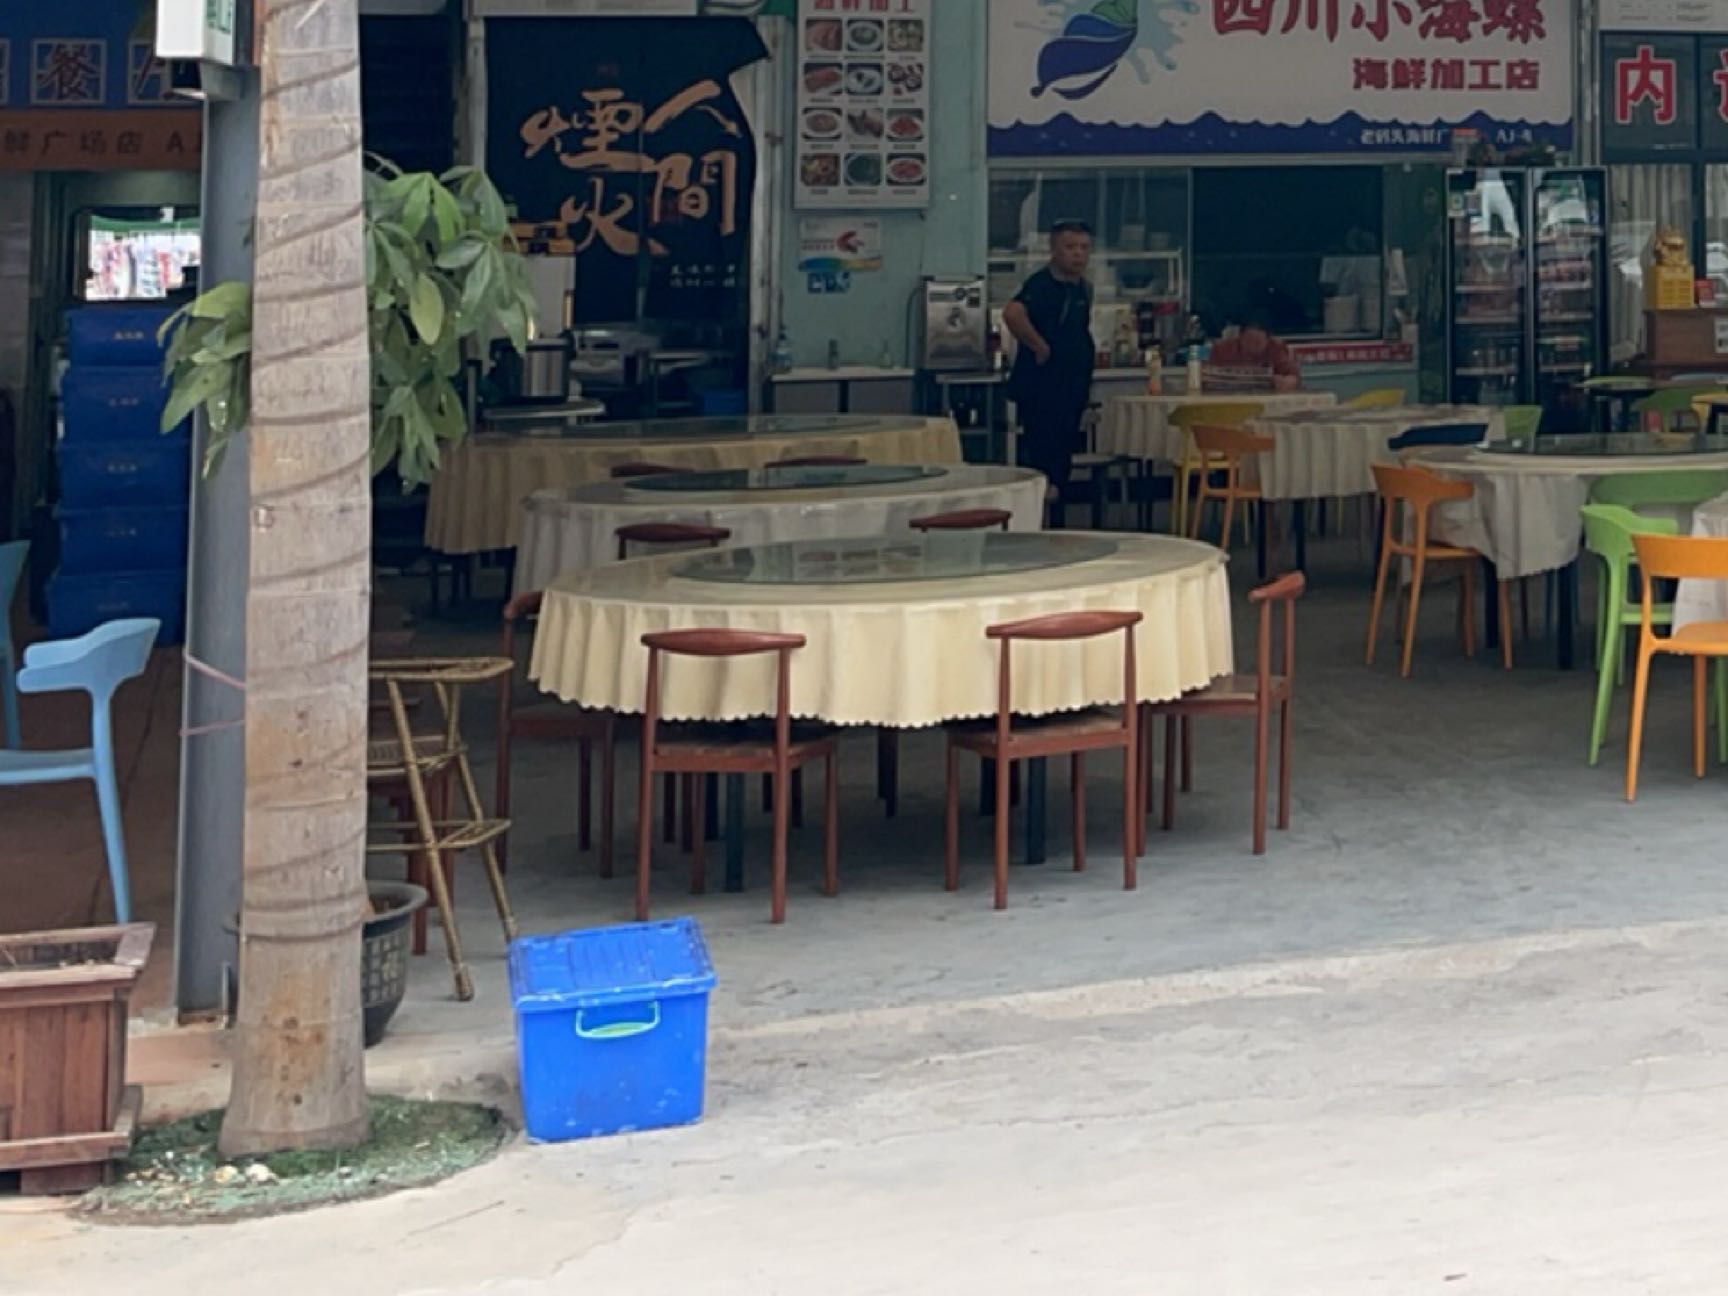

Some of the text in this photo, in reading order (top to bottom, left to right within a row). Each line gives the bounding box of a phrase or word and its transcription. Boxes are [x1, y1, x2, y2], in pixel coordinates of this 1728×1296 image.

[1353, 58, 1541, 90] 海鲜加工店
